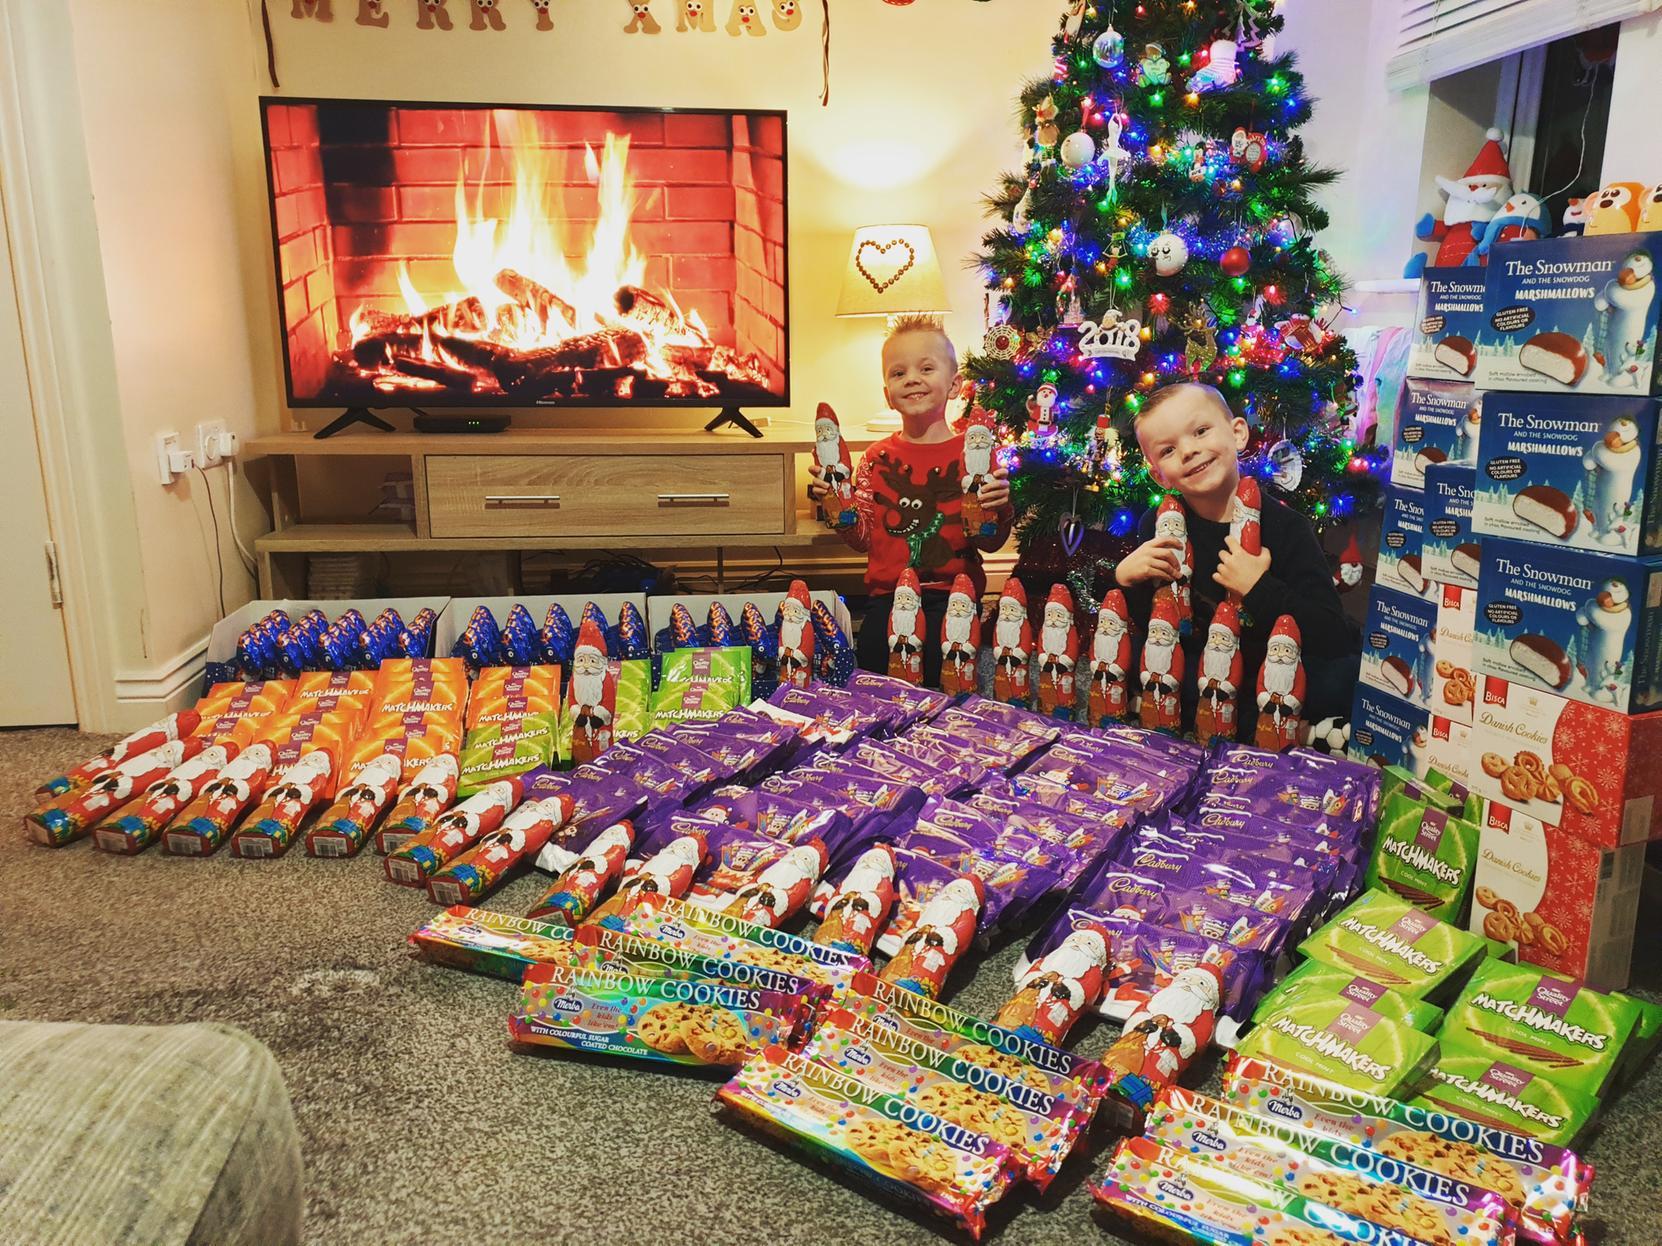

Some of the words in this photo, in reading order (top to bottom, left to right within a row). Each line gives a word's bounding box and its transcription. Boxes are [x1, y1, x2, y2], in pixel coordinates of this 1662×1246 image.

[1505, 260, 1533, 276] The
[1535, 259, 1612, 275] Snowman
[1431, 281, 1448, 293] The
[1553, 275, 1590, 284] SNOWDOG
[1515, 287, 1595, 302] MARSHMALLOWS
[1435, 303, 1484, 313] MARSHMALLOWS
[1078, 318, 1141, 352] 2018
[1411, 392, 1426, 404] The
[1427, 394, 1467, 409] Snowman
[1498, 413, 1524, 427] The
[1526, 415, 1599, 432] Snowman
[1529, 431, 1541, 439] THE
[1543, 433, 1578, 441] SNOWDOG
[1508, 442, 1584, 457] MARSHMALLOWS
[1437, 483, 1456, 496] The
[1395, 499, 1408, 512] The
[1496, 559, 1520, 576] The
[1523, 564, 1591, 590] Snowman
[1511, 578, 1524, 586] AND
[1525, 580, 1537, 588] THE
[1538, 582, 1572, 596] SNOWDOG
[1505, 588, 1577, 612] MARSHMALLOWS
[1376, 600, 1391, 614] The
[1391, 605, 1428, 628] Snowman
[1485, 691, 1505, 704] BISCA
[382, 701, 454, 713] MATCHMAKERS
[655, 708, 725, 720] MATCHMAKERS
[1361, 698, 1375, 712] The
[1375, 704, 1411, 730] Snowman
[1479, 711, 1514, 733] Danish
[1515, 723, 1549, 744] Cookies
[475, 727, 548, 749] MATCHMAKERS
[462, 754, 540, 775] MATCHMAKERS
[1232, 753, 1274, 768] Cadbury
[1489, 816, 1508, 830] BISCA
[1134, 853, 1182, 872] Cadbury
[1382, 836, 1461, 885] MATCHMAKERS
[1481, 849, 1511, 870] Danish
[1512, 862, 1541, 881] Cookies
[1108, 877, 1159, 899] Cadbury
[465, 908, 547, 933] RAINBOW
[1398, 922, 1419, 936] Street
[1400, 916, 1427, 933] Quality
[663, 898, 756, 939] RAINBOW
[759, 929, 850, 967] COOKIES
[1339, 917, 1441, 974] MATCHMAKERS
[600, 931, 697, 969] RAINBOW
[702, 957, 799, 996] COOKIES
[551, 966, 655, 995] RAINBOW
[660, 981, 760, 1010] COOKIES
[1346, 989, 1371, 1002] Street
[1348, 983, 1376, 999] Quality
[1536, 985, 1571, 1002] Quality
[555, 998, 580, 1011] Merba
[1536, 993, 1565, 1007] Street
[874, 981, 967, 1032] RAINBOW
[971, 1022, 1072, 1075] COOKIES
[1337, 1019, 1363, 1035] Street
[1339, 1012, 1370, 1031] Quality
[1471, 992, 1608, 1050] MATCHMAKERS
[531, 1025, 549, 1035] WITH
[549, 1028, 588, 1041] COLOURFUL
[588, 1034, 609, 1043] SUGAR
[581, 1040, 608, 1051] COATED
[608, 1044, 648, 1055] CHOCOLATE
[1272, 1017, 1392, 1082] MATCHMAKERS
[849, 1016, 950, 1068] RAINBOW
[952, 1060, 1056, 1115] COOKIES
[1489, 1068, 1525, 1085] Quality
[1489, 1074, 1519, 1089] Street
[782, 1053, 882, 1104] RAINBOW
[884, 1098, 989, 1155] COOKIES
[1263, 1060, 1398, 1116] RAINBOW
[1405, 1105, 1544, 1163] COOKIES
[1269, 1100, 1300, 1120] Merba
[1195, 1132, 1225, 1150] Merba
[1191, 1094, 1321, 1154] RAINBOW
[1330, 1143, 1470, 1207] COOKIES
[1160, 1181, 1194, 1200] Merba
